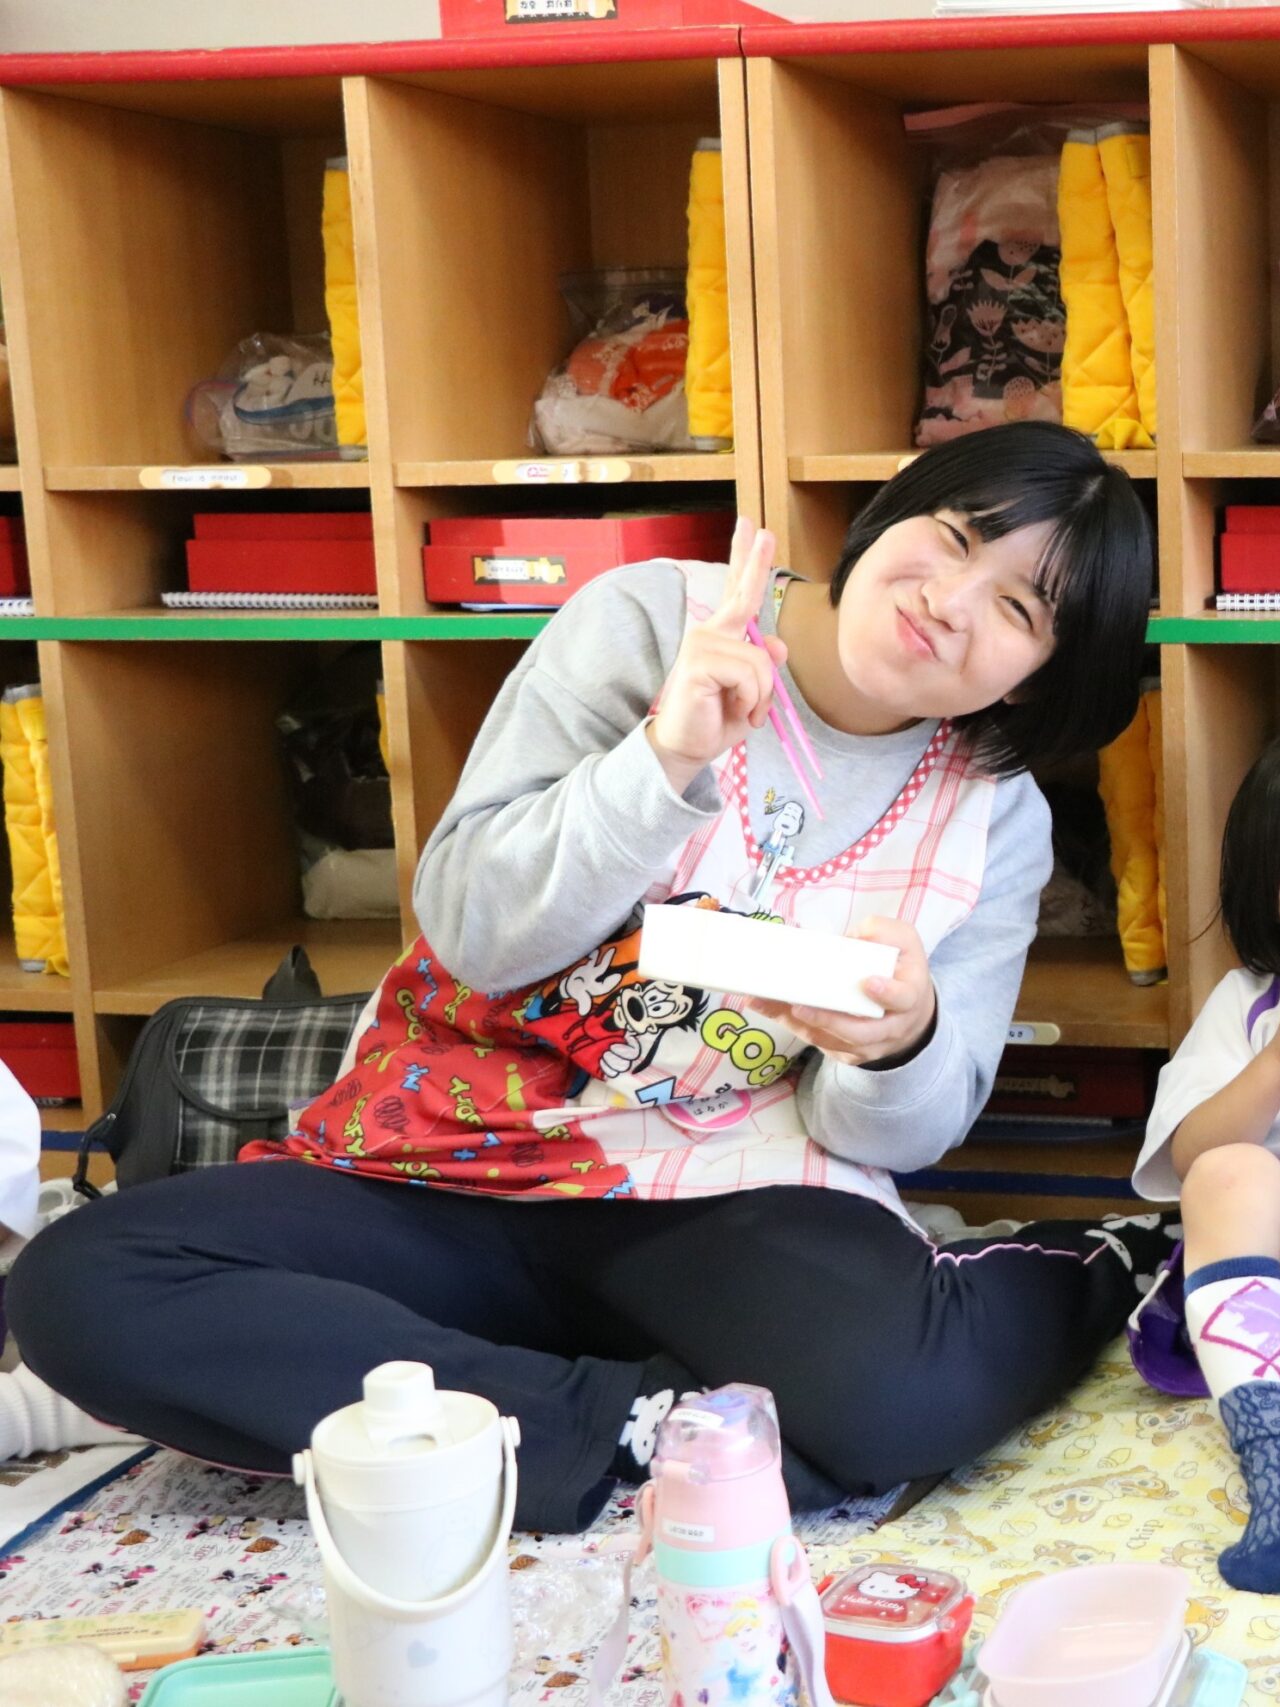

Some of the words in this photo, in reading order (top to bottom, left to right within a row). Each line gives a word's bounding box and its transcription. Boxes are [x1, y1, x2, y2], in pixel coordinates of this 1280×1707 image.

[700, 1008, 793, 1086] GOO
[1126, 1519, 1164, 1549] Chip
[874, 1600, 905, 1612] Kitty
